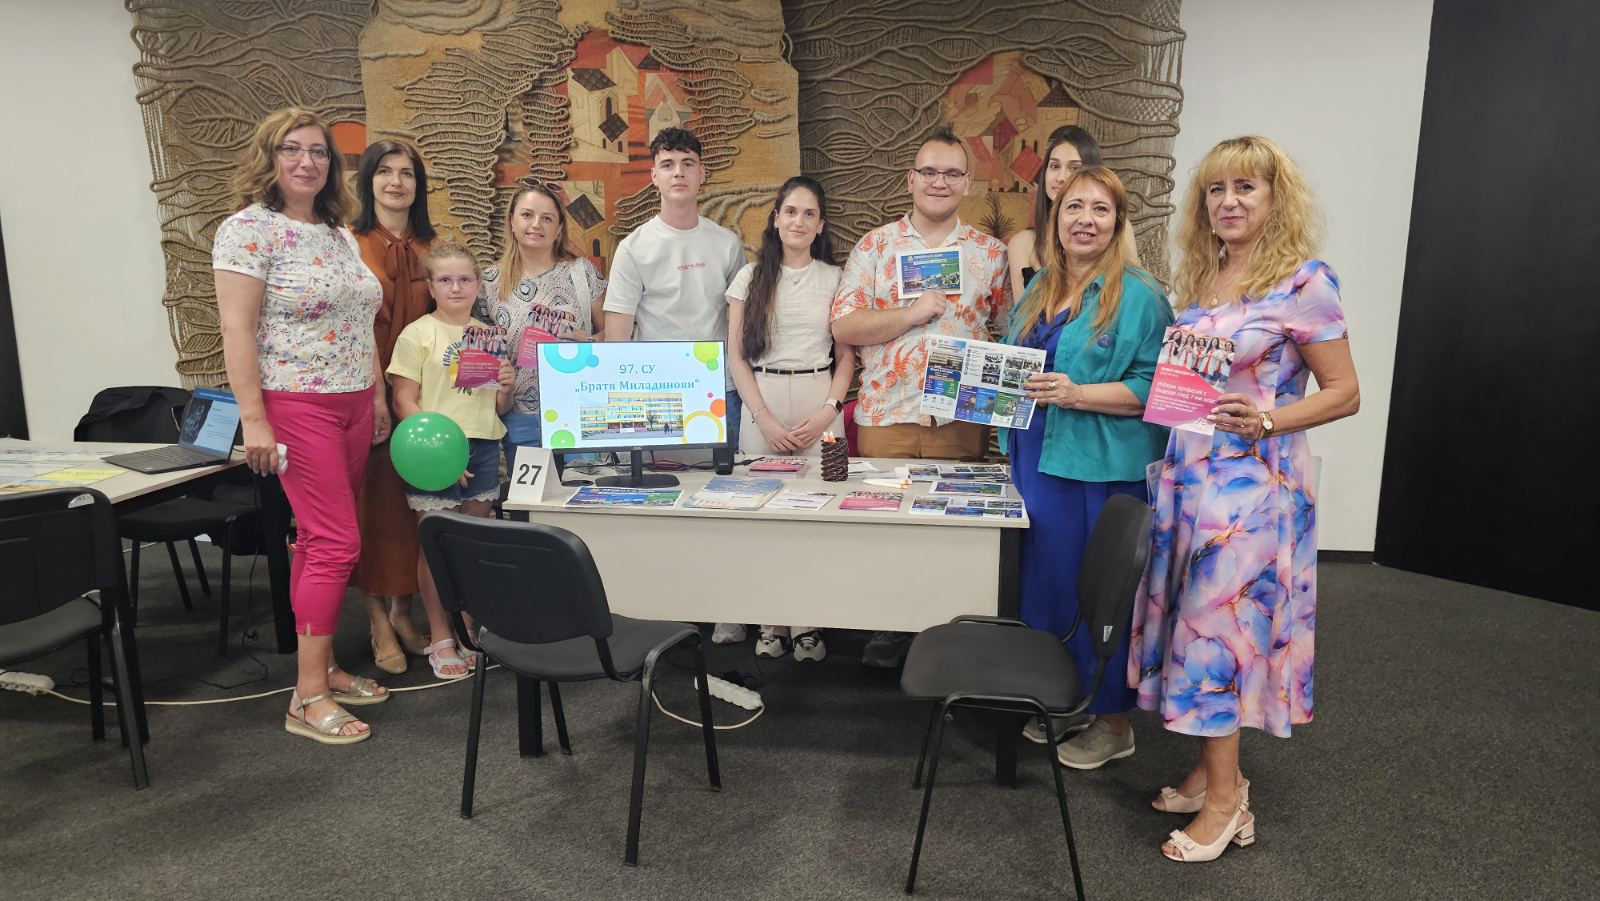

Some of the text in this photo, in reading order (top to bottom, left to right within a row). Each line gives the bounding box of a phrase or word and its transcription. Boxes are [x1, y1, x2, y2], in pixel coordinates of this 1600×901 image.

[619, 364, 656, 374] 97. СУ
[575, 378, 700, 393] „Братя Миладинови“
[516, 463, 543, 486] 27
